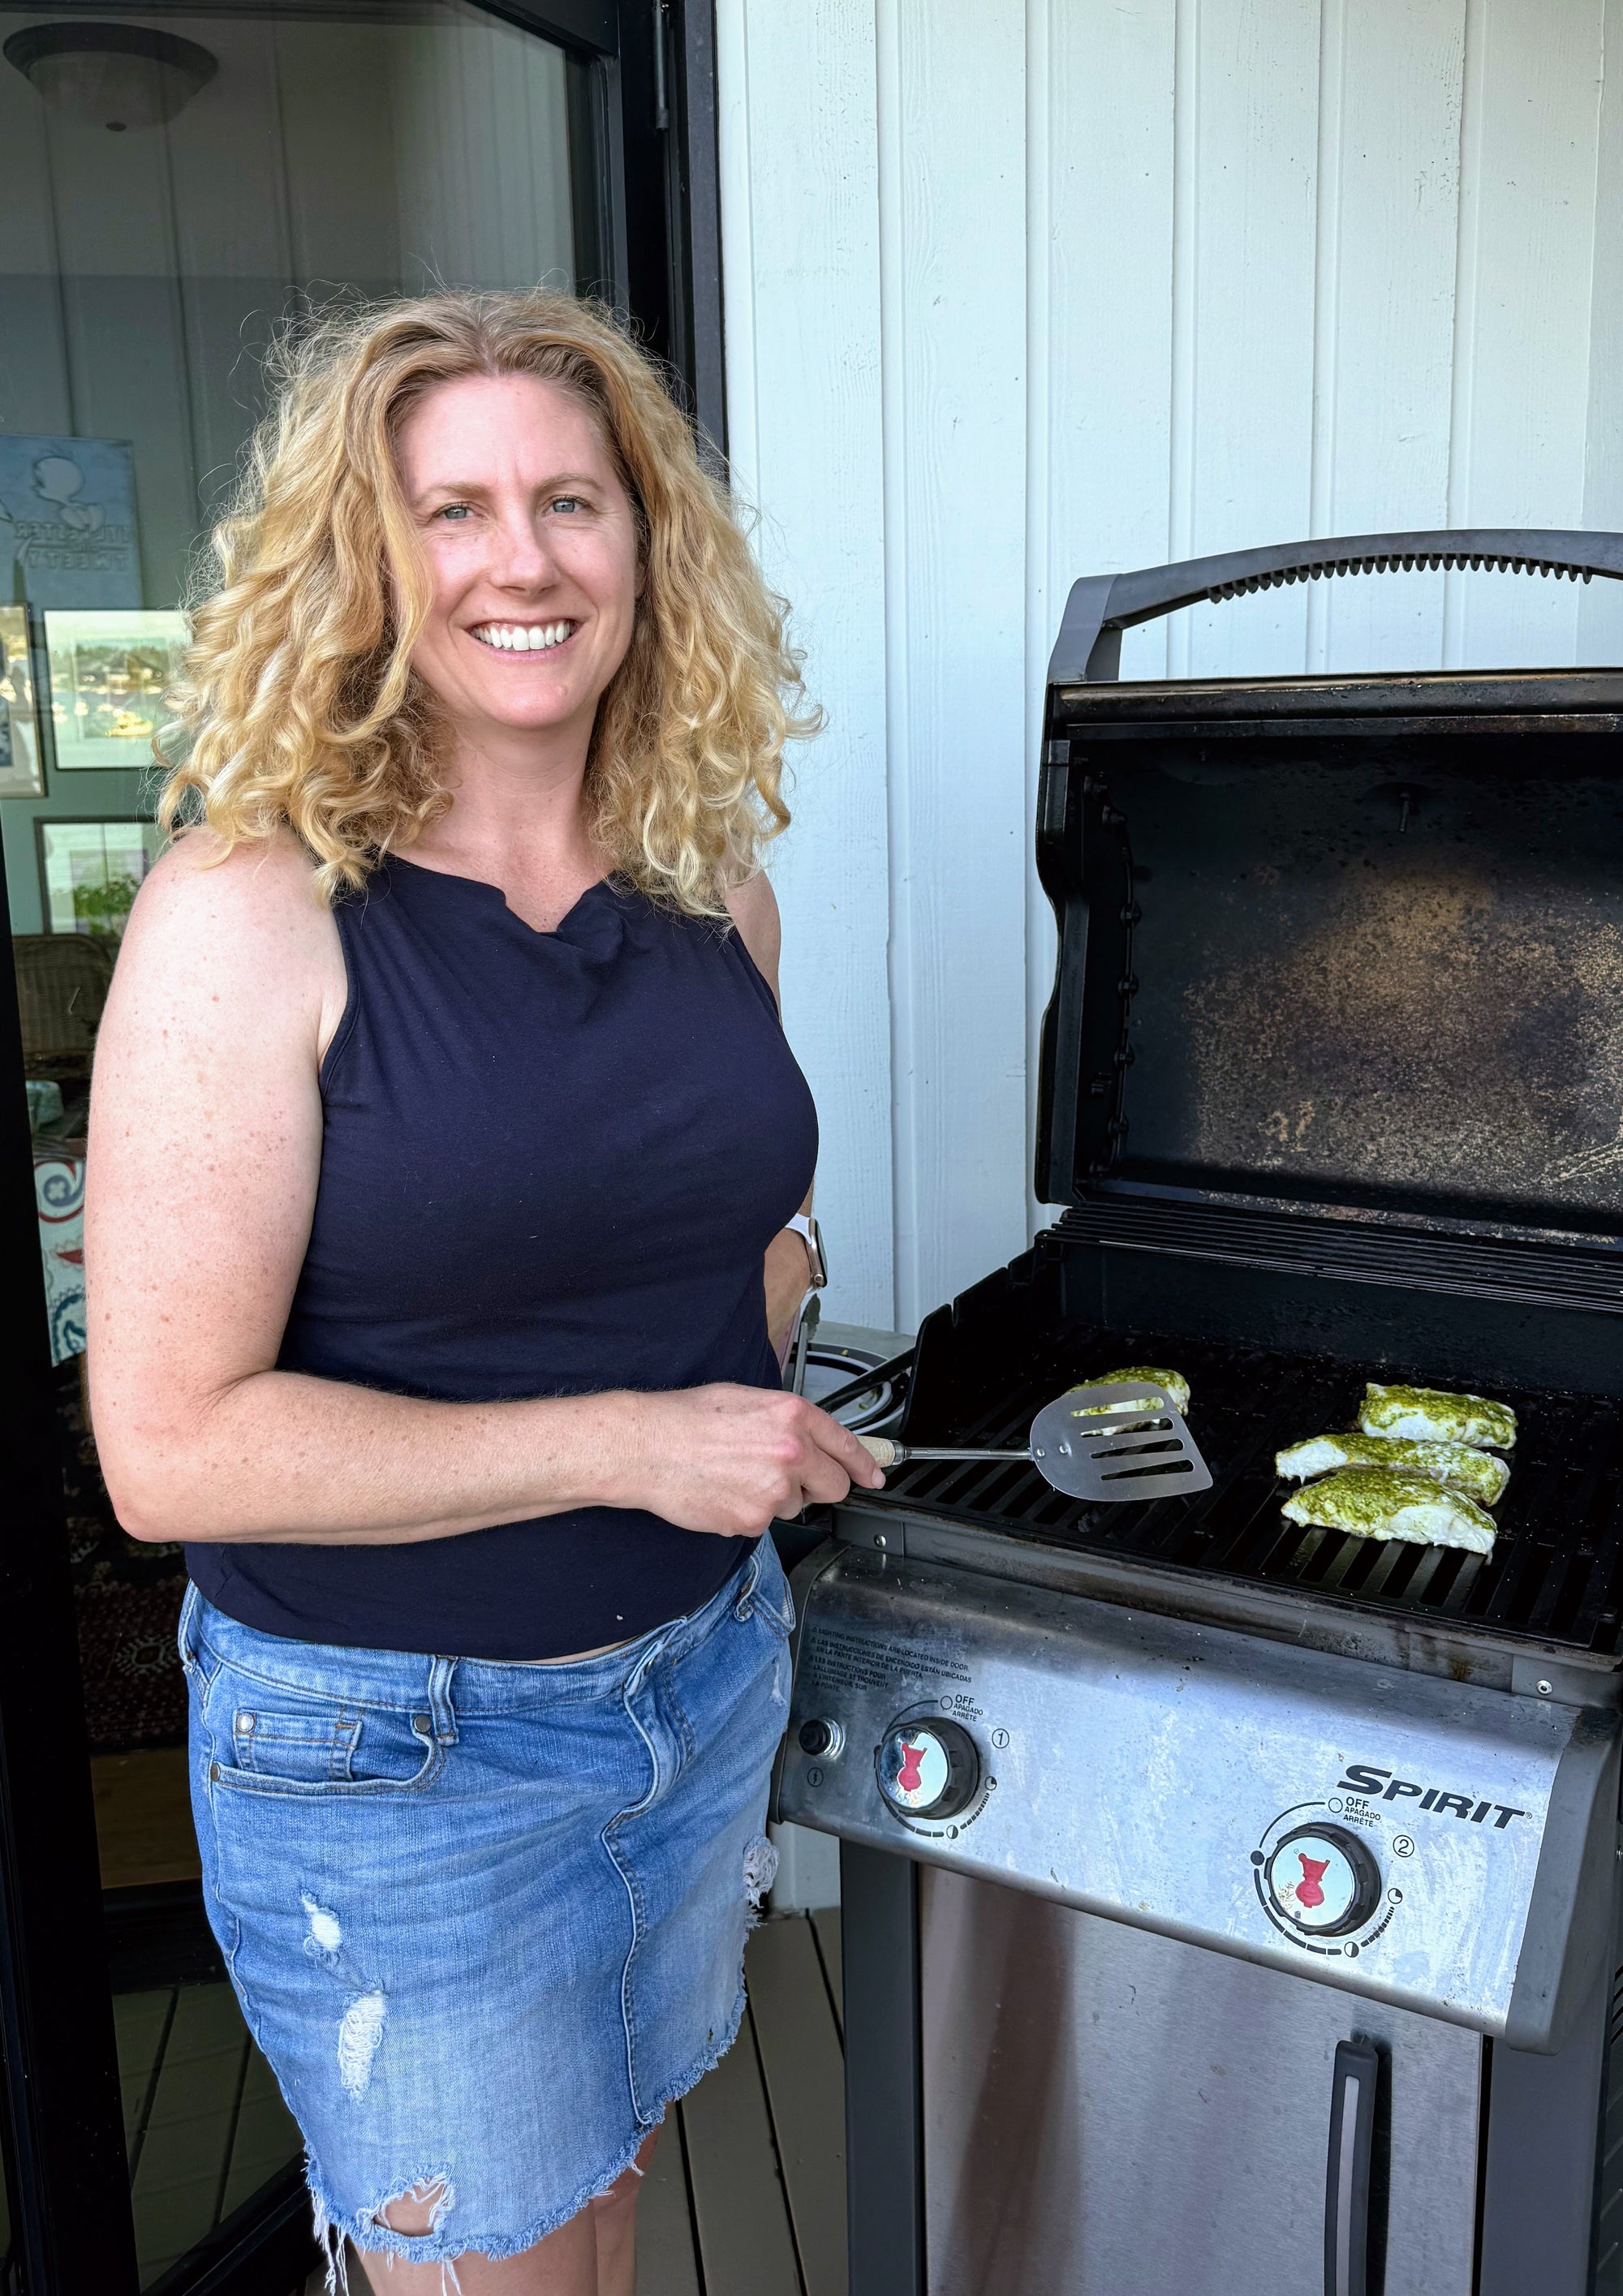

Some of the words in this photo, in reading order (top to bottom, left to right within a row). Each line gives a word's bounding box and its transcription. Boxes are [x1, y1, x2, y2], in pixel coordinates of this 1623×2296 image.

[817, 1639, 829, 1647] LAS
[829, 1642, 876, 1659] INSTRUCCIONES
[885, 1656, 920, 1670] ENCENDIDO
[920, 1666, 941, 1675] ESTÁN
[941, 1670, 972, 1683] UBICADAS
[833, 1651, 853, 1660] PARTE
[854, 1656, 880, 1667] INTERIOR
[901, 1649, 929, 1661] LOCATED
[929, 1656, 949, 1666] INSIDE
[856, 1675, 889, 1688] TROUVENT
[869, 1670, 886, 1680] POUR
[855, 1683, 867, 1692] SUR
[955, 1694, 975, 1705] OFF
[954, 1703, 983, 1715] APAGADO
[952, 1710, 977, 1722] ARRÊTE
[1346, 1796, 1369, 1809] OFF
[1343, 1814, 1374, 1827] ARRÊTE
[1345, 1807, 1381, 1821] APAGADO
[1398, 1839, 1409, 1855] 2
